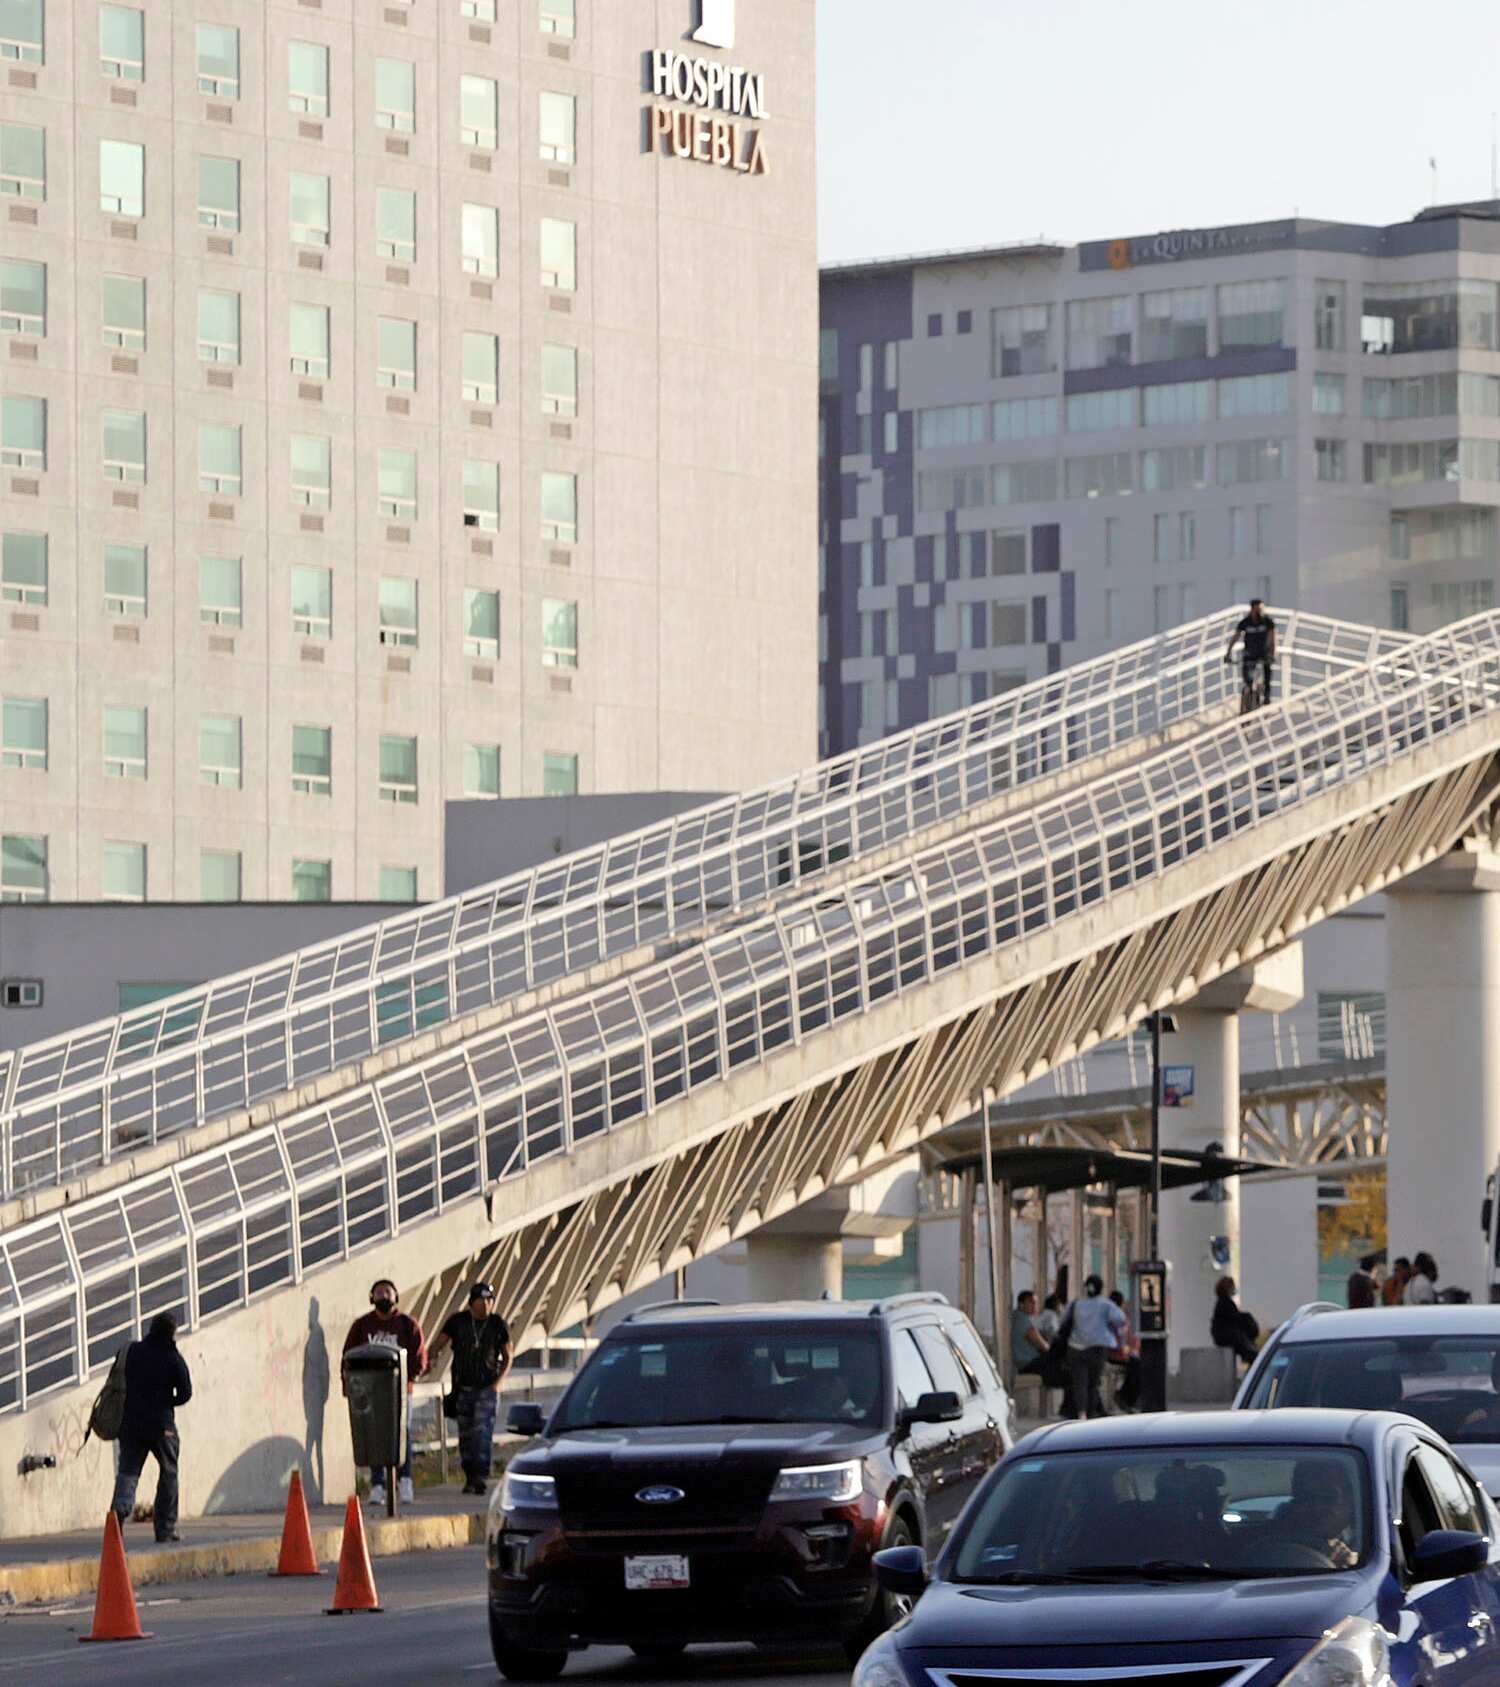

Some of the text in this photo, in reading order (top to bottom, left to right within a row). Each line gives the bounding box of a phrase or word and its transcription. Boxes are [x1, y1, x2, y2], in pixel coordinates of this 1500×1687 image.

[652, 49, 770, 119] HOSPITAL
[652, 103, 770, 175] PUEBLA
[1153, 231, 1230, 259] QUINTA
